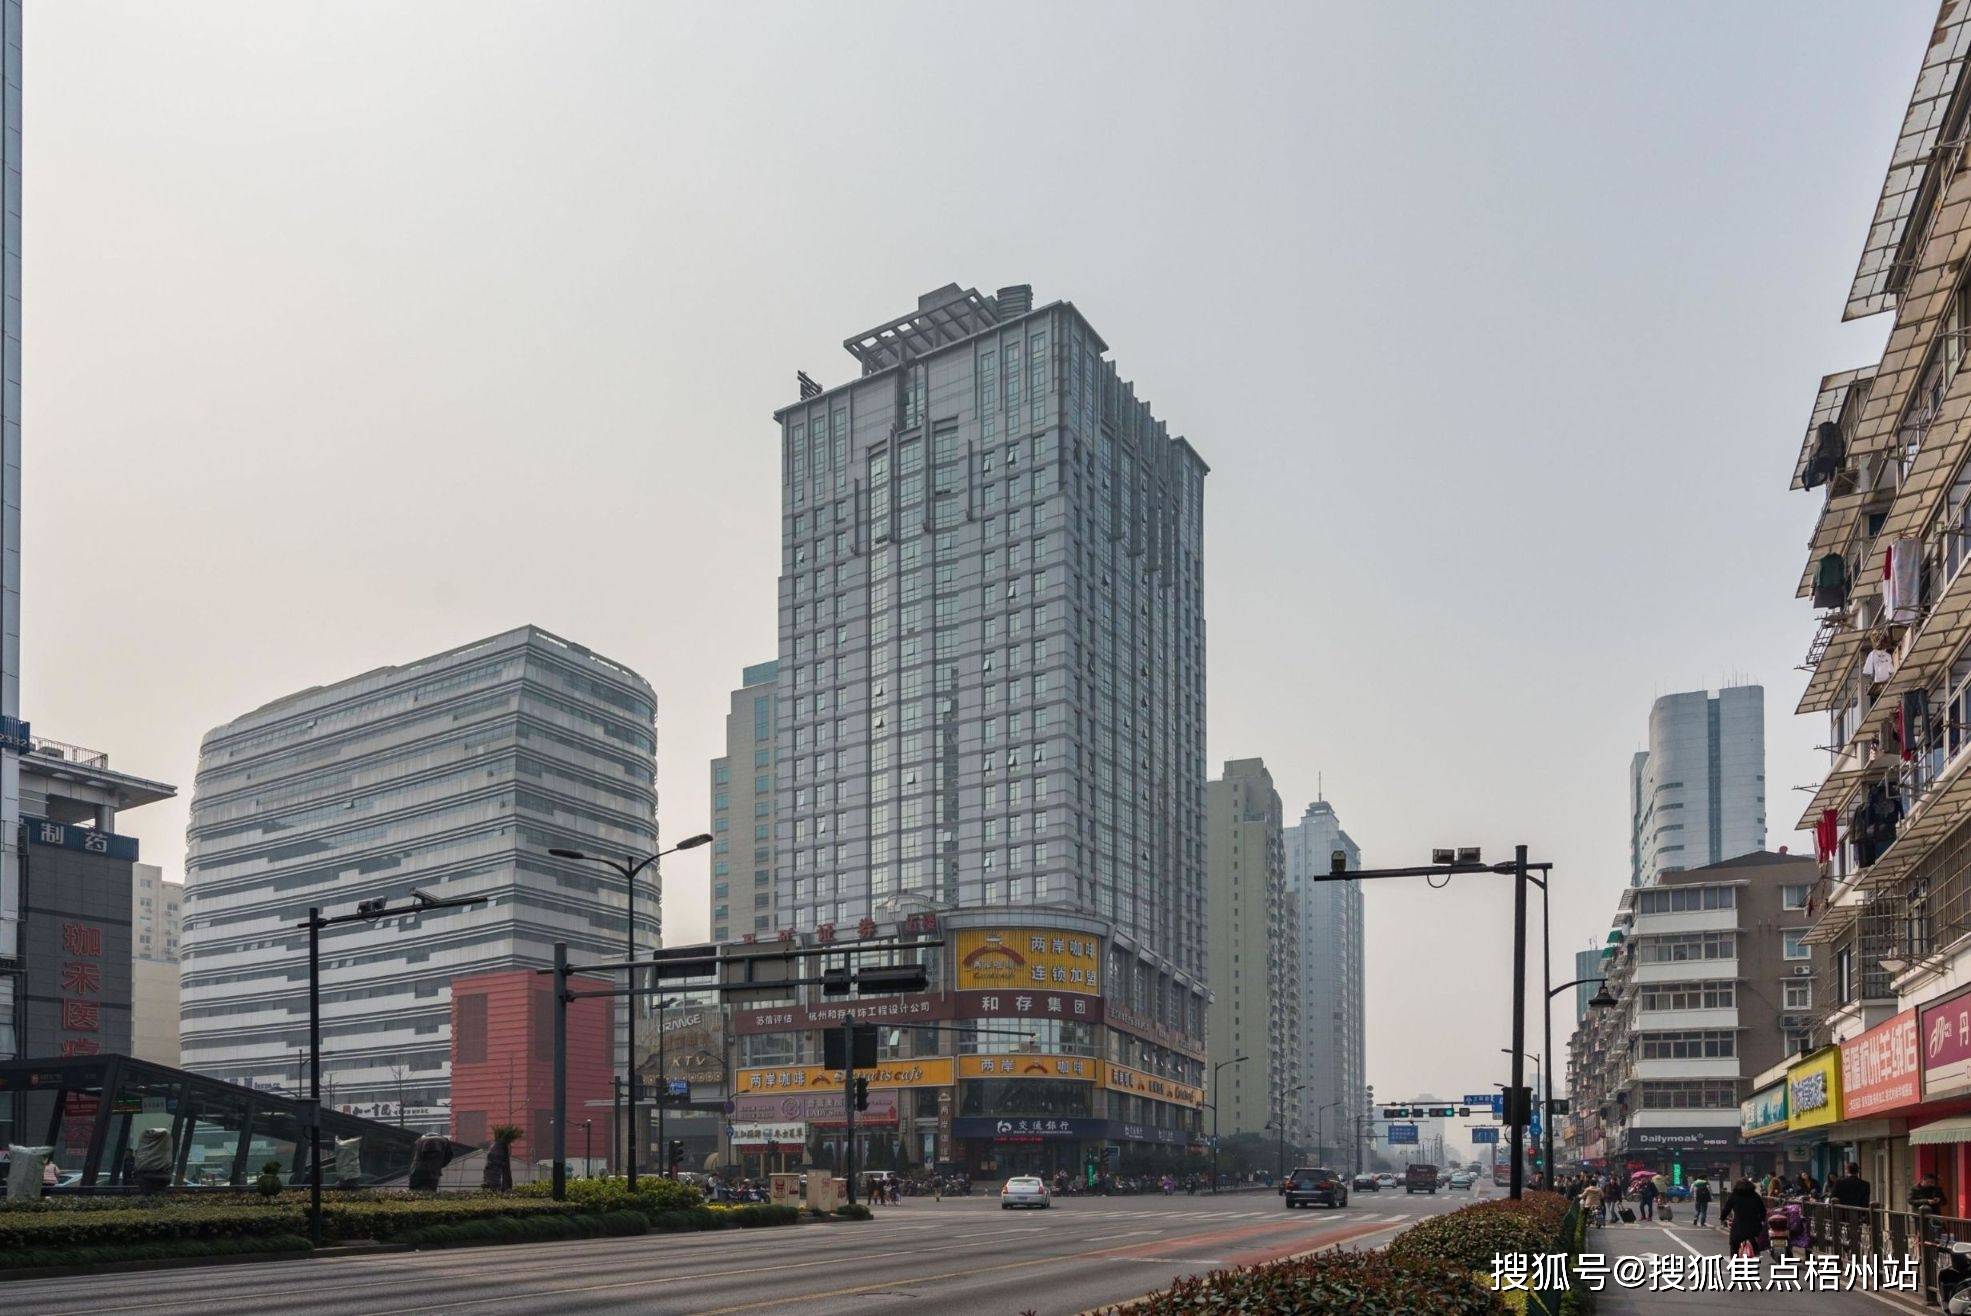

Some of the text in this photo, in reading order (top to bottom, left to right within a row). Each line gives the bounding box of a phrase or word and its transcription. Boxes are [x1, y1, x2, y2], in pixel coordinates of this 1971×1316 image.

[1030, 936, 1096, 960] 两岸咖啡
[1030, 965, 1097, 987] 连锁加盟
[982, 995, 1086, 1014] 和存集团
[656, 1014, 702, 1034] ORANGE
[672, 1055, 705, 1067] KTV
[980, 1059, 1084, 1075] 两岸 咖啡
[750, 1070, 805, 1088] 两岸咖啡
